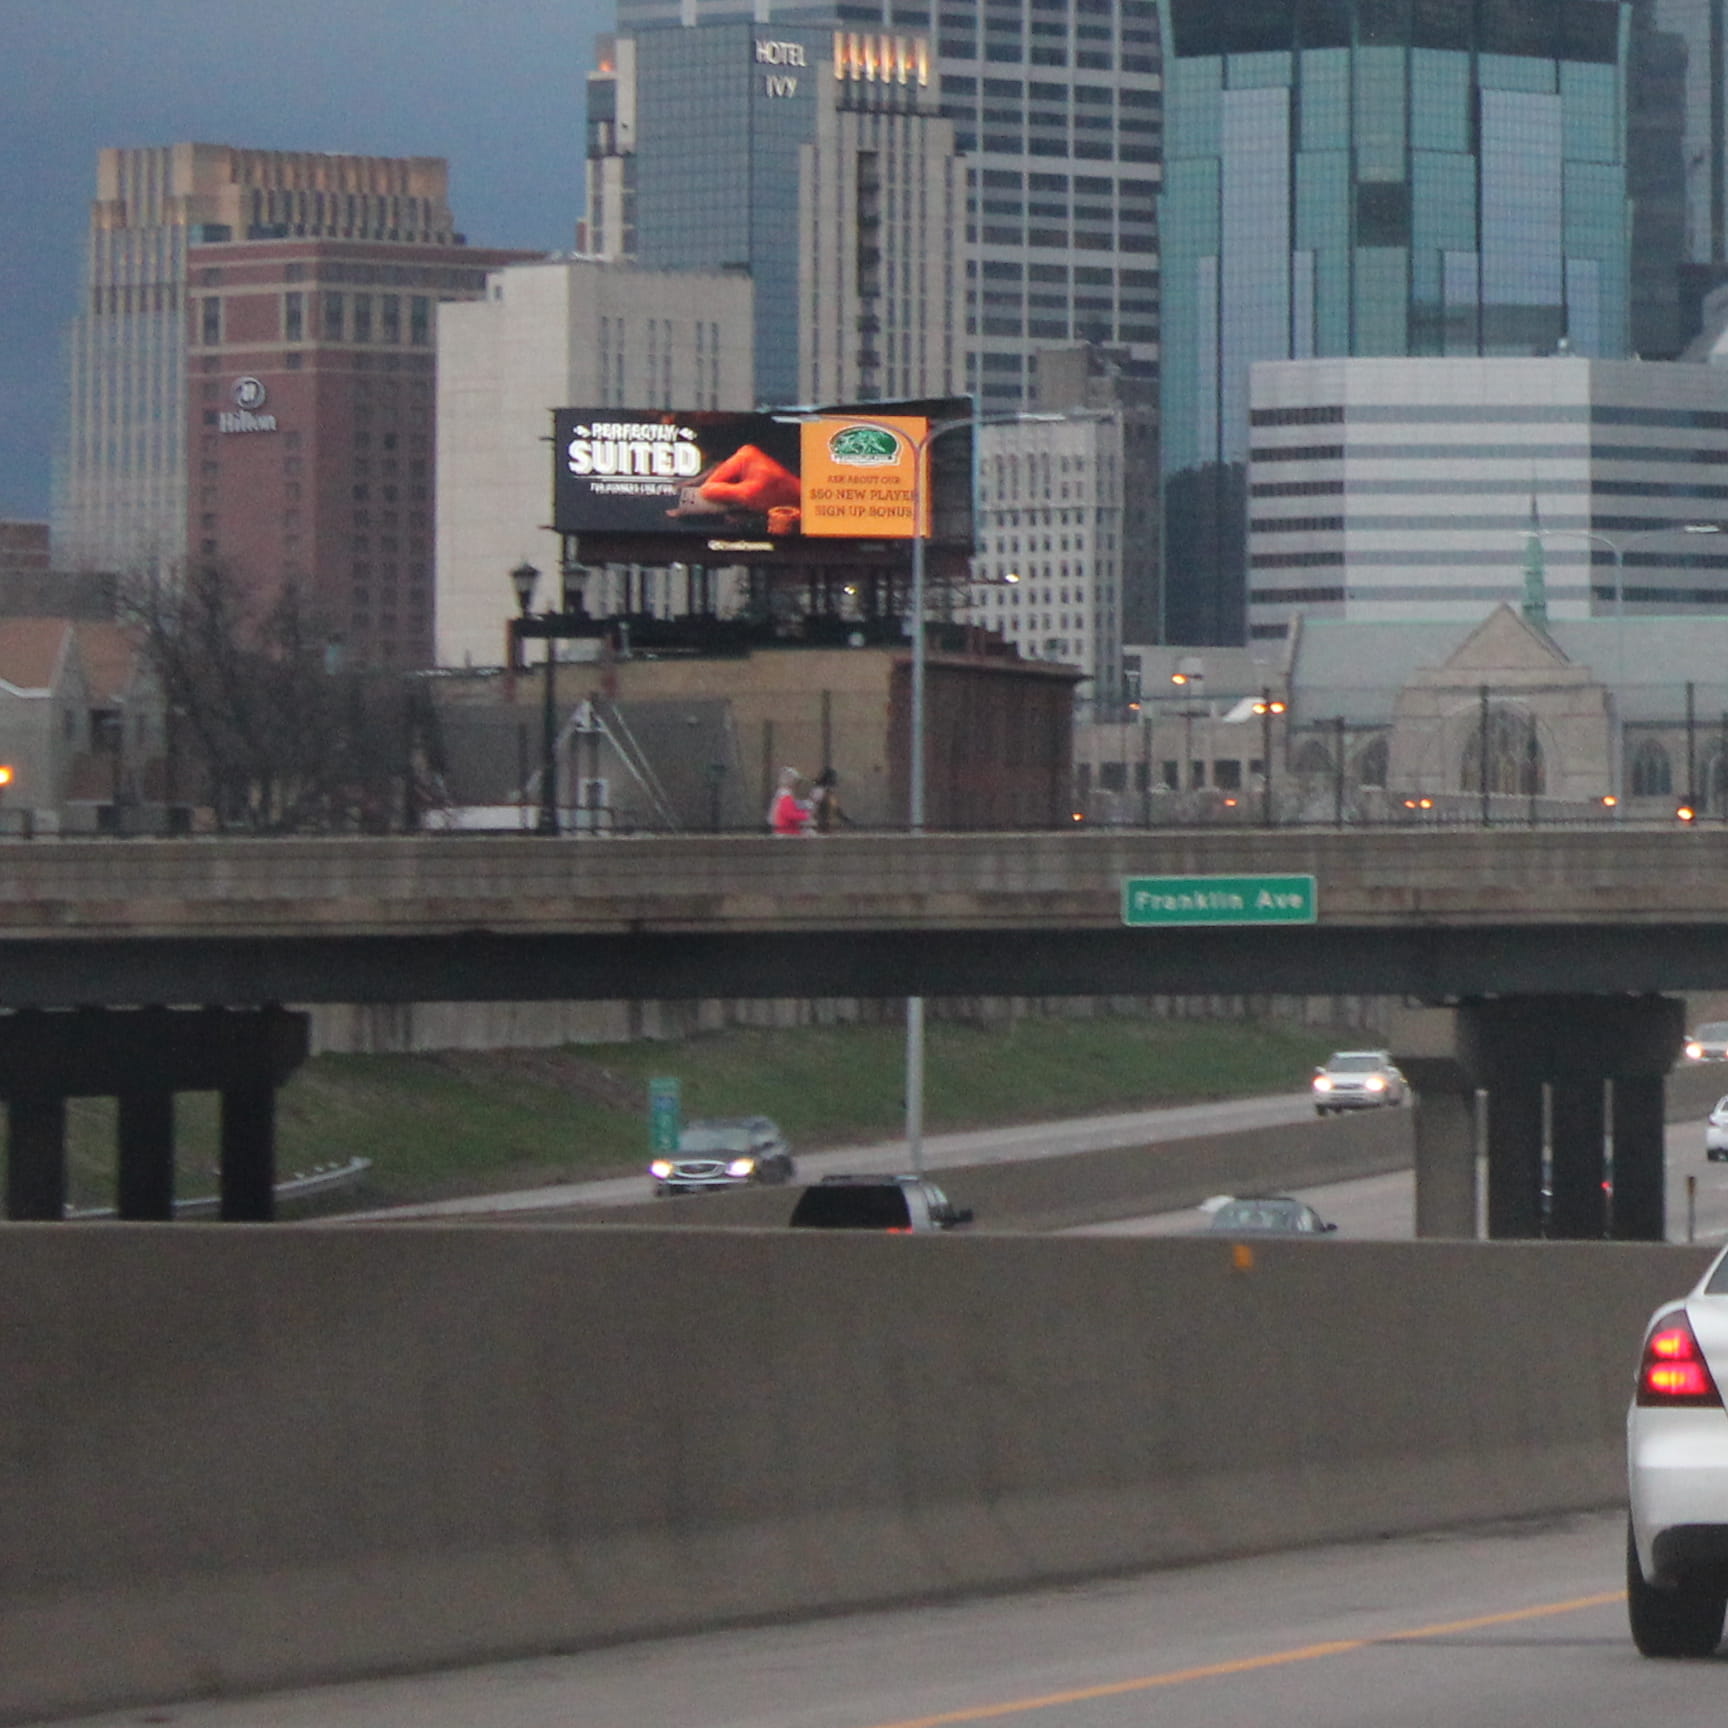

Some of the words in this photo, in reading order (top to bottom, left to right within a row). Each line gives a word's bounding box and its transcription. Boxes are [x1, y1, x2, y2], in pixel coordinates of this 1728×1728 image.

[756, 40, 807, 67] HOTEL
[766, 75, 797, 98] IVY
[592, 423, 678, 440] PERFECTLY
[568, 439, 701, 476] SUITED
[848, 475, 879, 484] ABOUT
[836, 489, 866, 500] NEW
[815, 505, 845, 516] SIGN
[849, 506, 865, 517] UP
[869, 506, 913, 518] BONUS
[1134, 890, 1244, 910] Franklin
[1255, 889, 1303, 909] Ave
